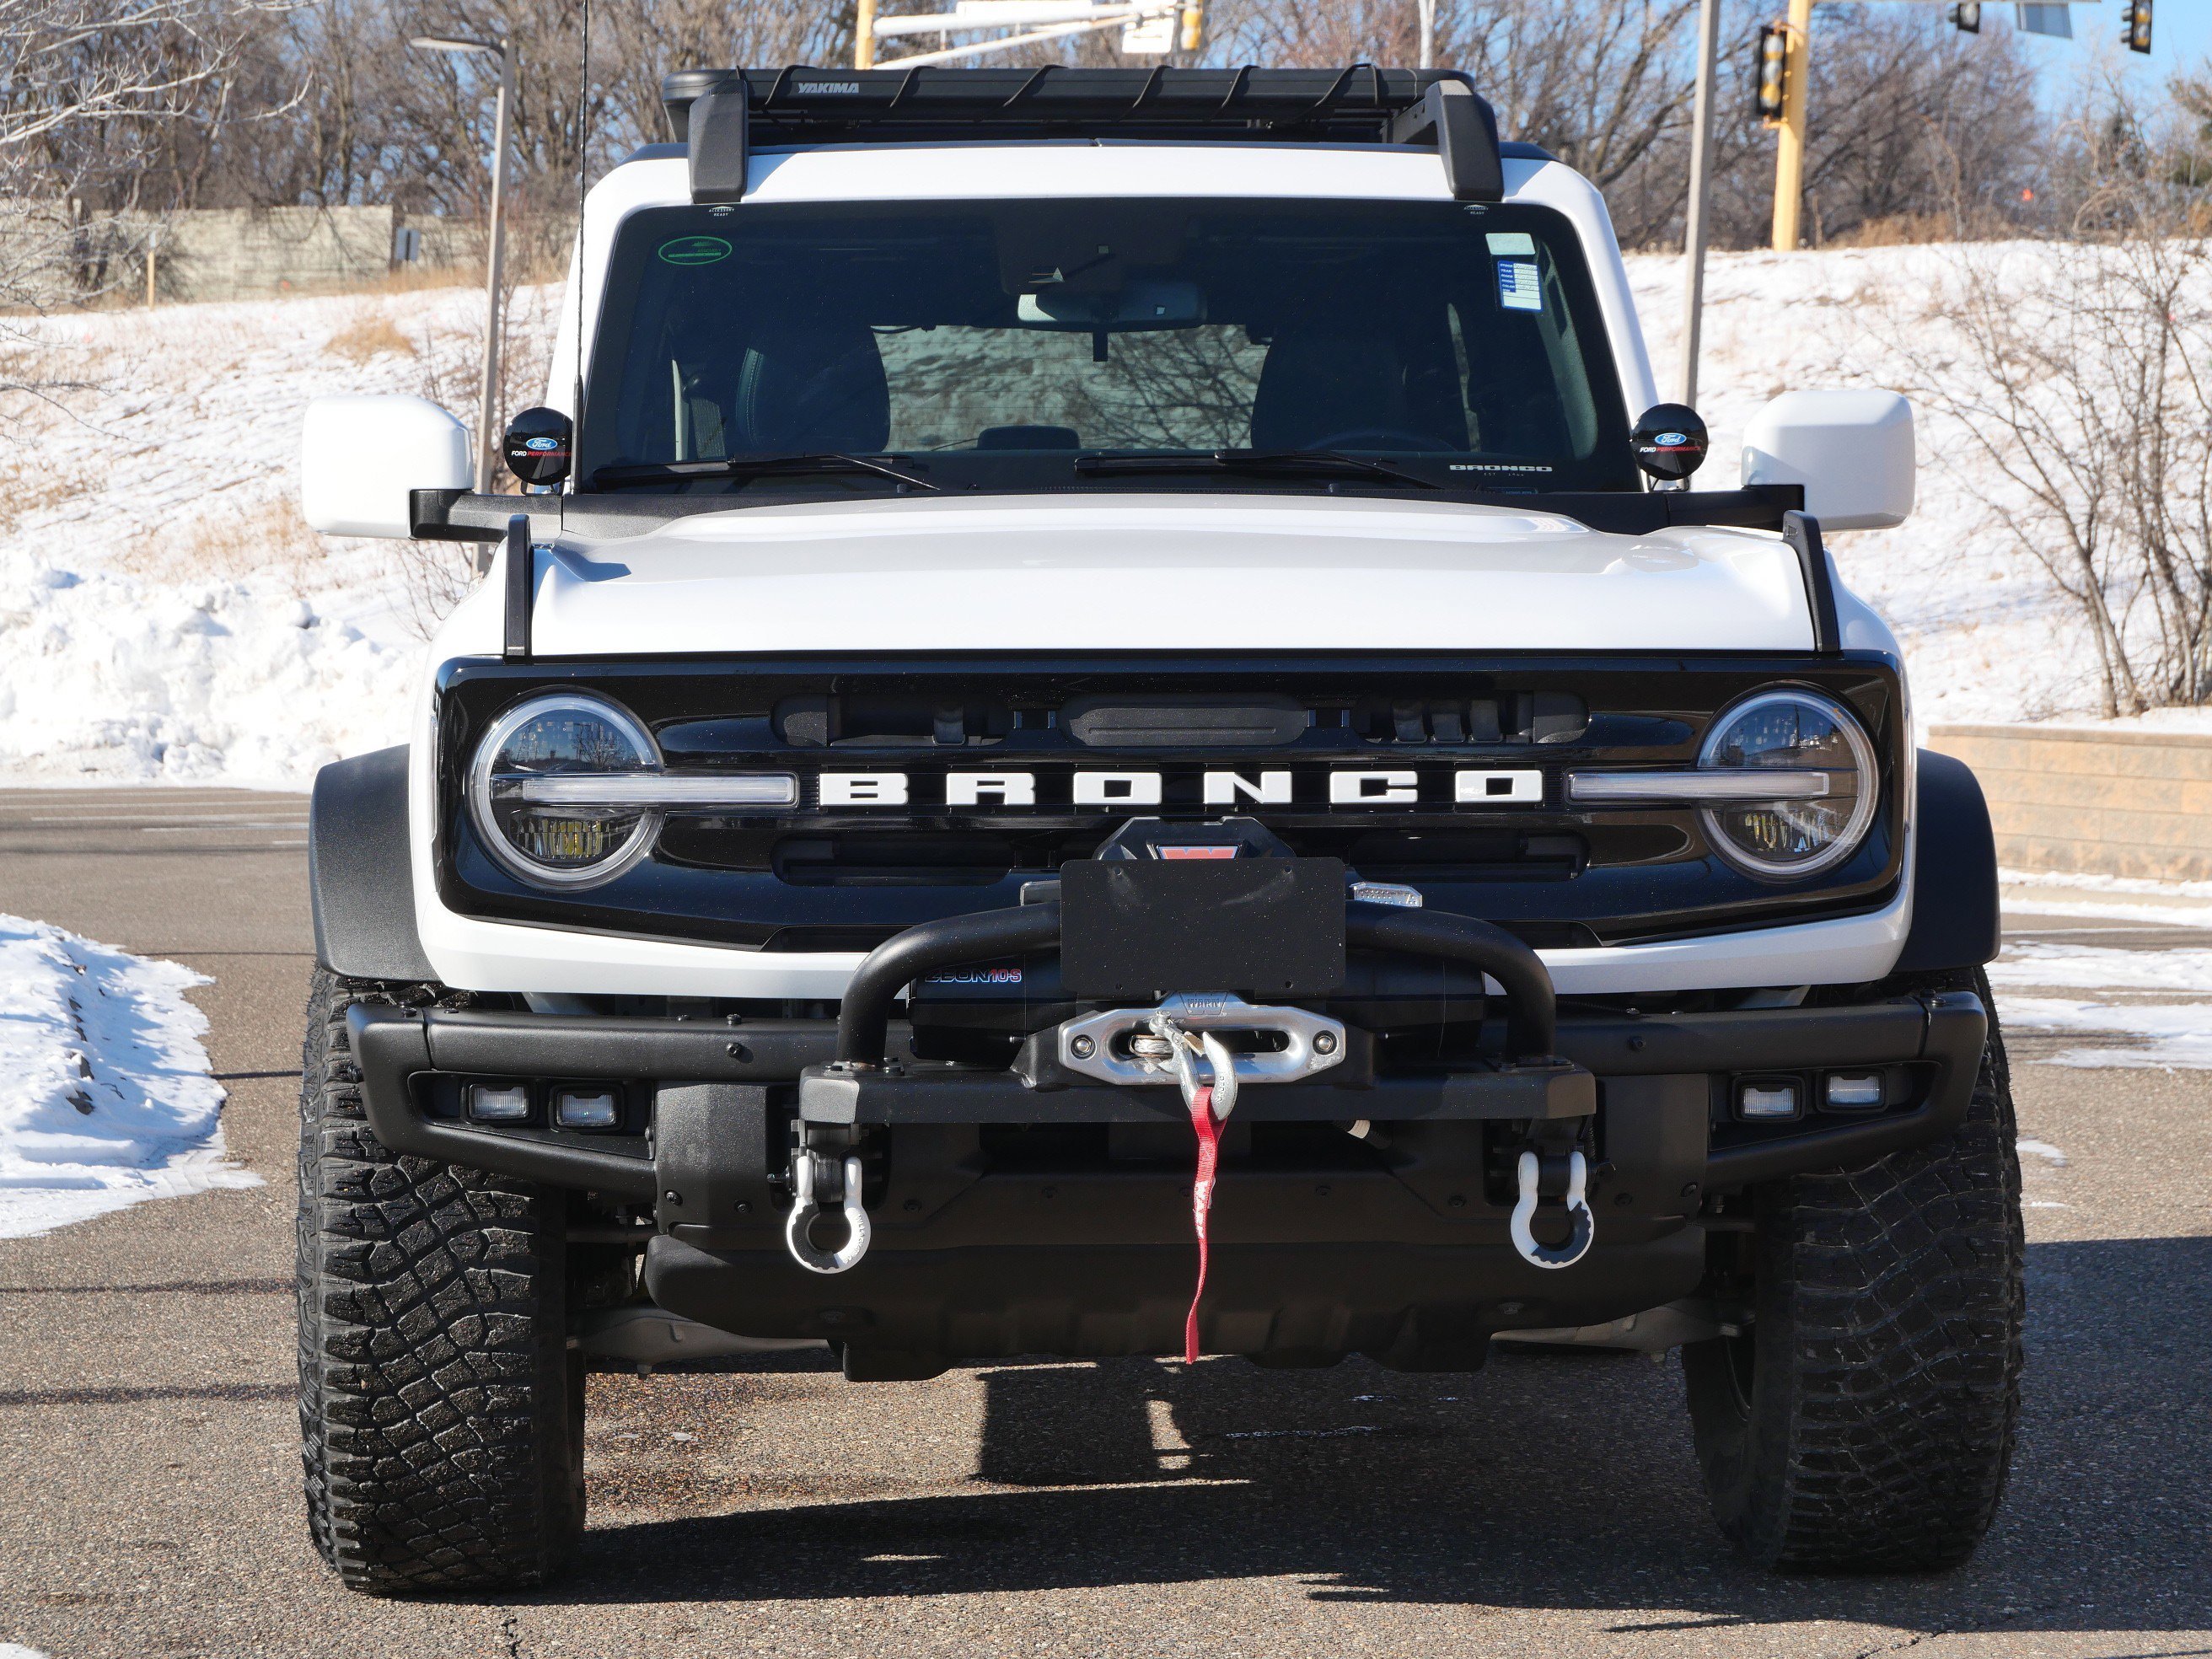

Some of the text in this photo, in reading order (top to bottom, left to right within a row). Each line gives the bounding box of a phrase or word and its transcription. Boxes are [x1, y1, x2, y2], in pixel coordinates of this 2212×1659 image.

[798, 83, 859, 94] YAKIMA
[531, 438, 552, 448] Ford
[1661, 434, 1683, 443] Ford
[819, 770, 1543, 806] BRONCO
[1187, 998, 1221, 1008] WARN
